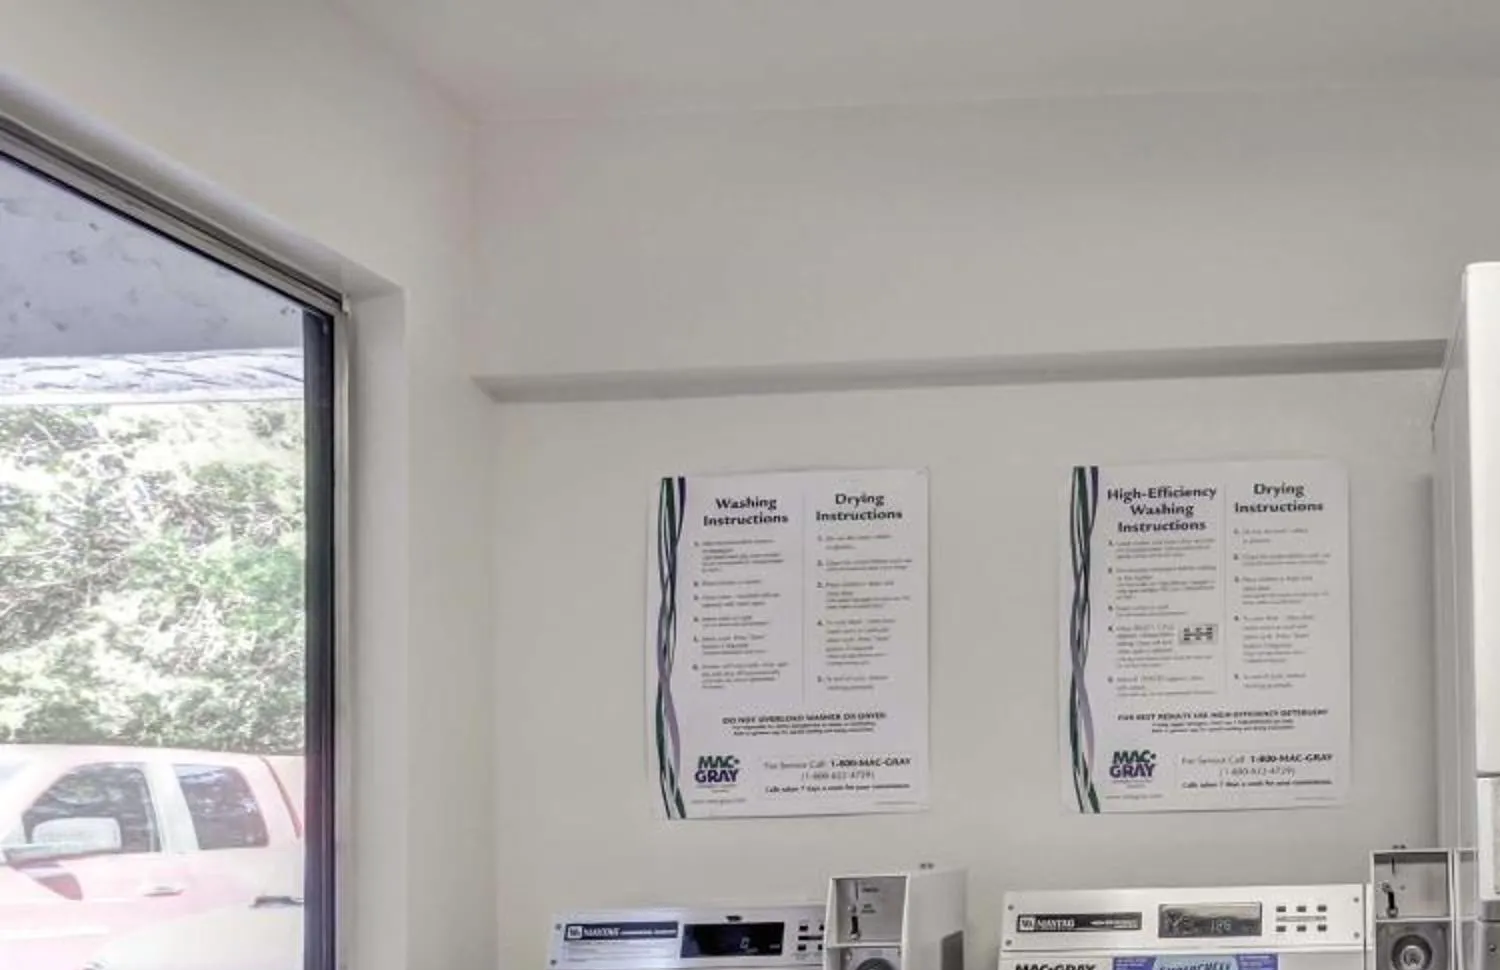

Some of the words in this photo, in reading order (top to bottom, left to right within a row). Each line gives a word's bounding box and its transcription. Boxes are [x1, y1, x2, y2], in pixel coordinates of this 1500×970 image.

[1107, 486, 1217, 504] High-Efficiency
[1253, 483, 1305, 498] Drying
[714, 495, 778, 510] Washing
[834, 492, 885, 507] Drying
[1235, 499, 1323, 514] Instructions
[815, 507, 903, 522] Instructions
[1130, 502, 1195, 518] Washing
[703, 511, 789, 527] Instructions
[1117, 519, 1207, 534] Instructions
[695, 769, 740, 783] GRAY
[1109, 764, 1157, 778] GRAY
